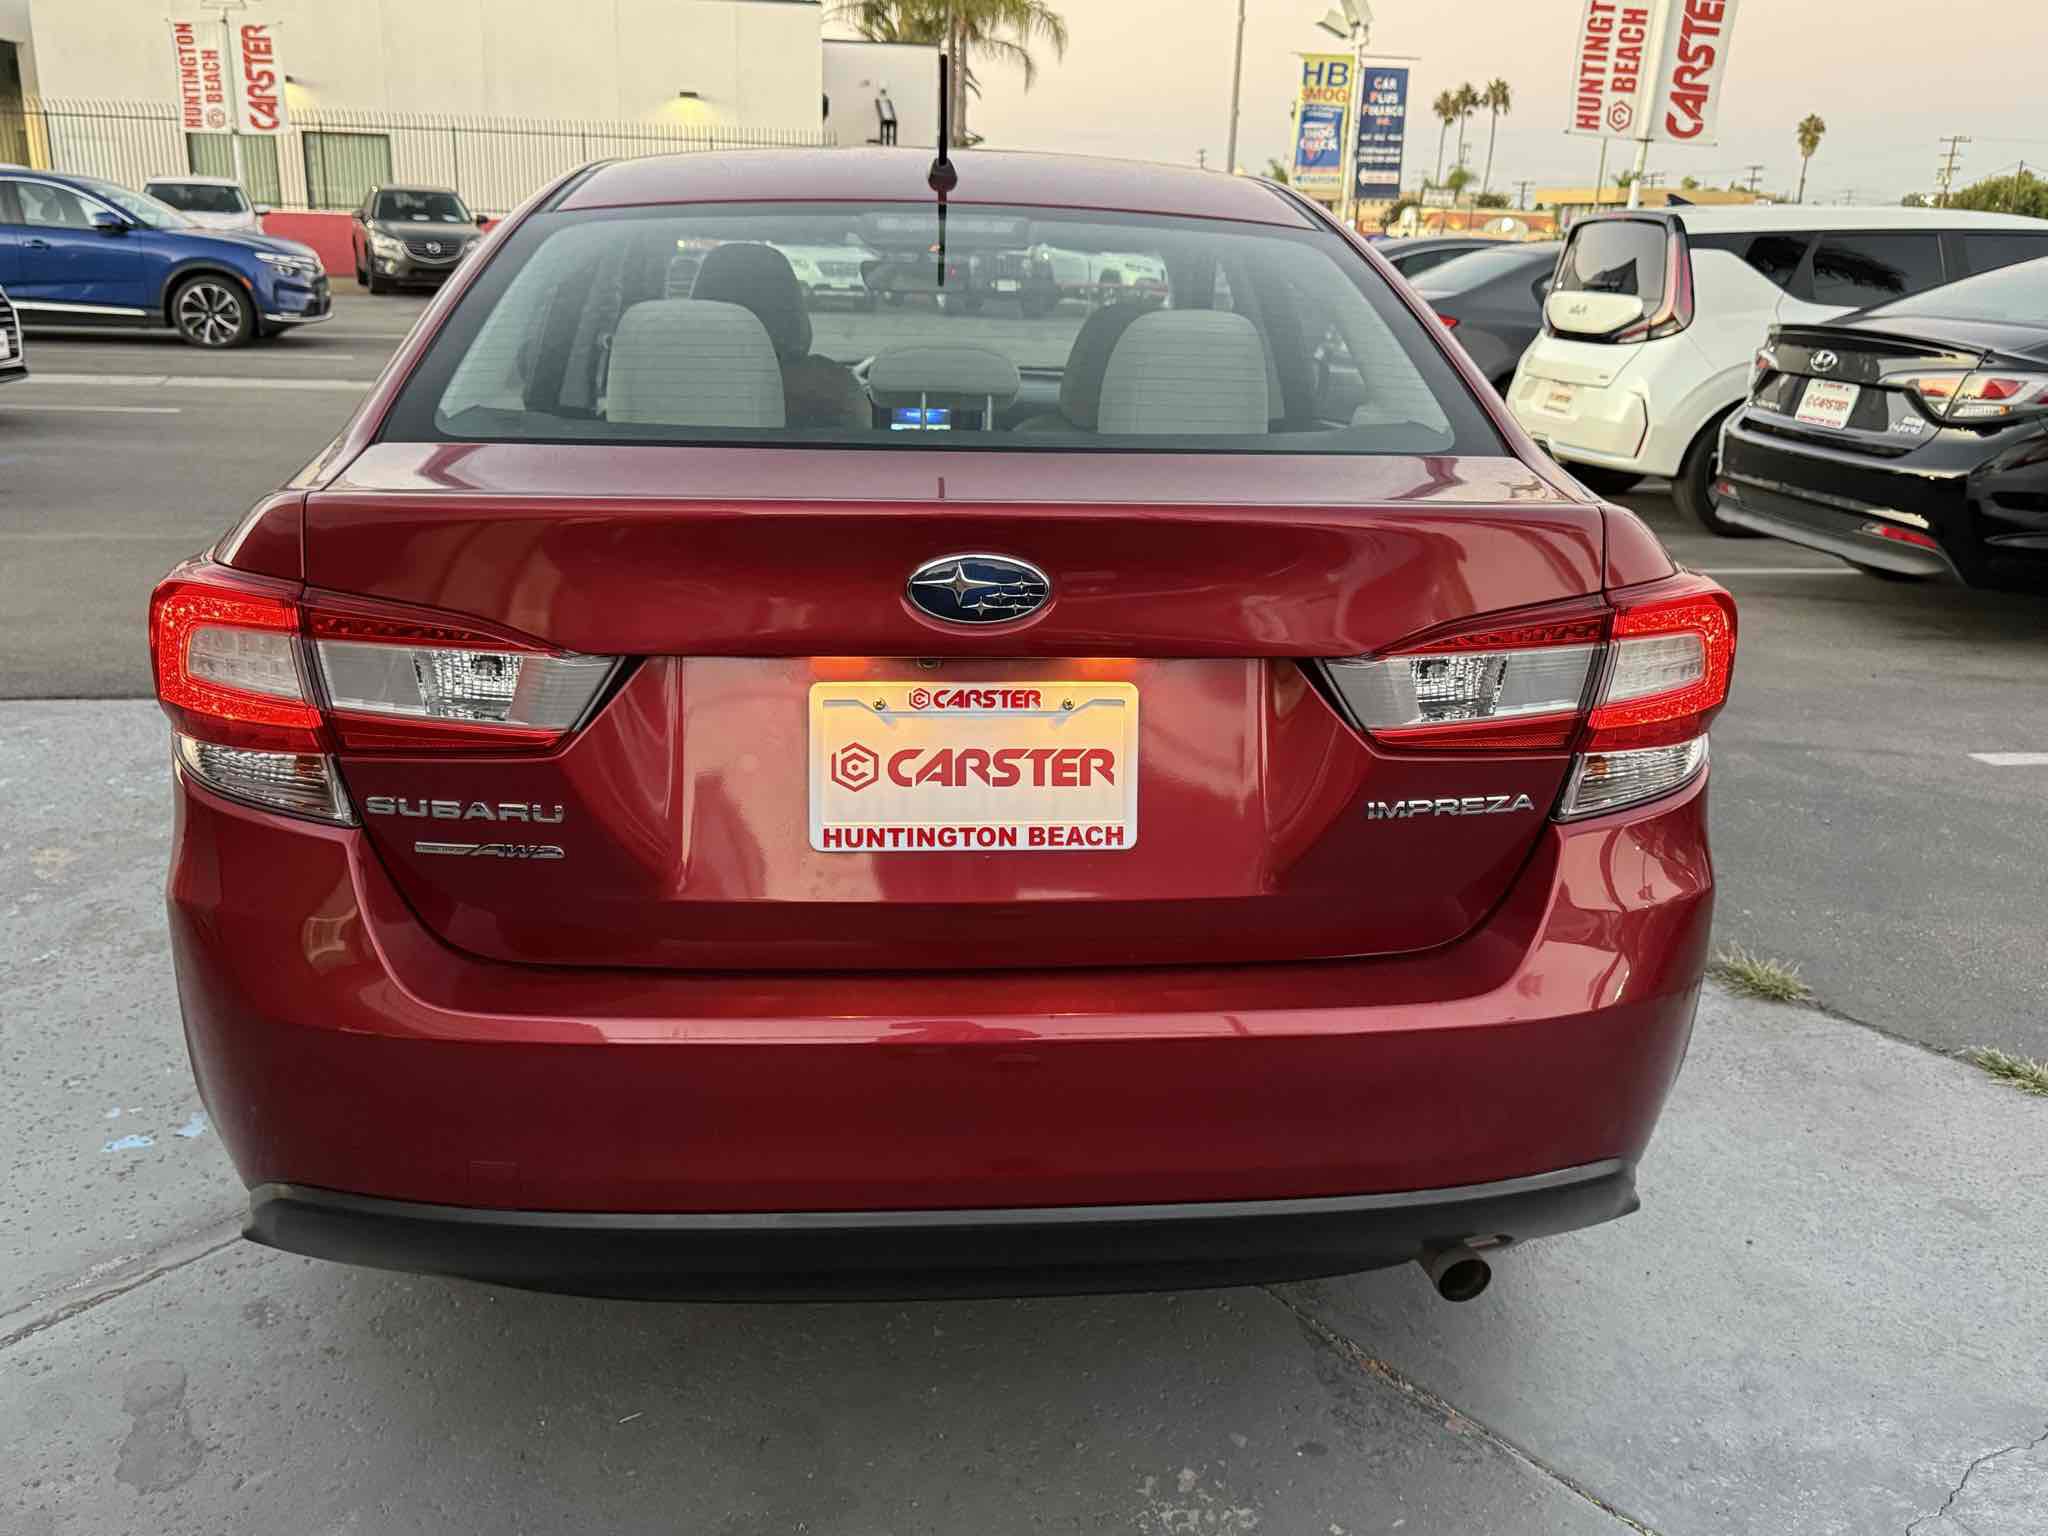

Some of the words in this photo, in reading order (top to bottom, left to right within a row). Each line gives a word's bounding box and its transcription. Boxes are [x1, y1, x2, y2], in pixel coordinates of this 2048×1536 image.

[1611, 8, 1648, 93] BEACH
[1666, 0, 1726, 139] CARSTE
[174, 23, 203, 128] HUNTINGTON
[201, 50, 223, 103] BEACH
[241, 24, 280, 129] CARSTER
[1302, 61, 1349, 87] HB
[933, 689, 1041, 709] CARSTER
[887, 748, 1116, 787] CARSTER
[366, 796, 564, 824] SUBARU
[1367, 793, 1535, 820] IMPREZA
[823, 827, 1018, 849] HUNTINGTON
[1029, 826, 1125, 847] BEACH
